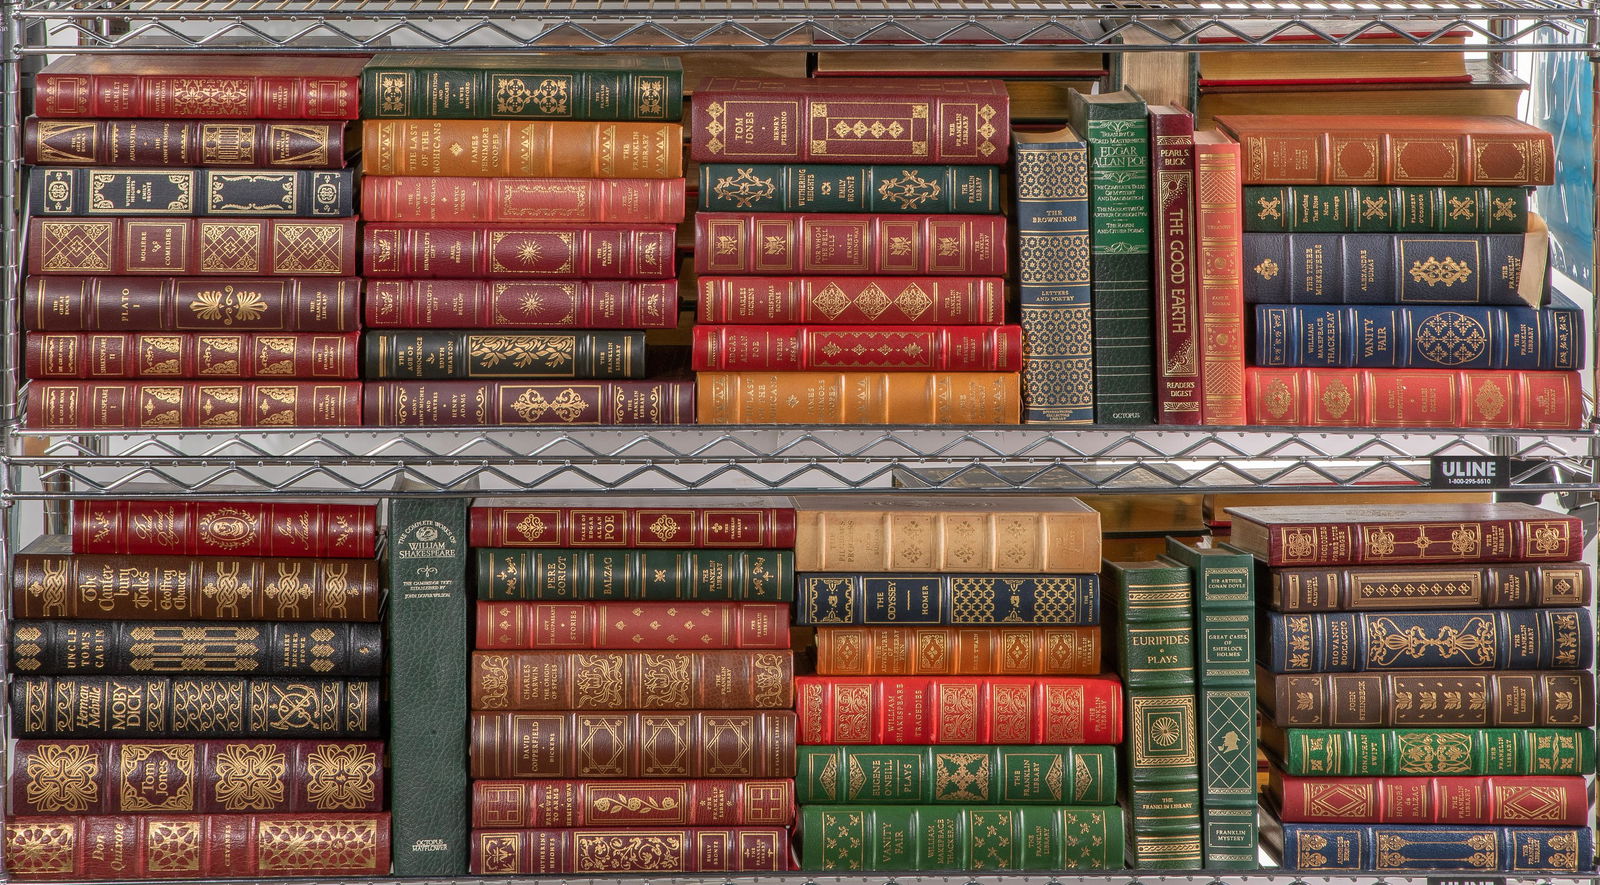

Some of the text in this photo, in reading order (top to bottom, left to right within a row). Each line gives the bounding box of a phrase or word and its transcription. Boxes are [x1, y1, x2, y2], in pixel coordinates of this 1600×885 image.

[735, 117, 743, 140] TOM
[746, 111, 754, 145] JONES
[409, 124, 418, 170] THE LAST
[421, 130, 429, 166] OF THE
[433, 122, 442, 174] MOHICANS
[481, 127, 489, 172] FENIMORE
[1091, 157, 1126, 168] ALLAN
[1100, 146, 1138, 158] EDGAR
[1160, 149, 1184, 157] PEARL
[1164, 158, 1186, 166] BUCK
[1169, 208, 1186, 334] THE GOOD EARTH
[1315, 244, 1323, 296] MUSKETEERS
[121, 288, 130, 321] PLATO
[408, 346, 413, 356] OF
[1327, 311, 1335, 364] THACKERAY
[1364, 318, 1374, 357] VANITY
[1378, 327, 1386, 351] FAIR
[1166, 381, 1195, 389] READER'S
[1442, 461, 1496, 476] ULINE
[278, 516, 296, 544] Jane
[295, 510, 309, 550] Austen
[604, 515, 615, 540] POE
[399, 550, 456, 559] SHAKESPEARE
[408, 542, 446, 550] WILLIAM
[80, 575, 98, 602] The
[115, 567, 139, 596] bury
[132, 571, 152, 609] Tales
[161, 570, 177, 610] Geoffrey
[174, 570, 187, 610] Chaucer
[557, 556, 567, 595] GORIOT
[604, 557, 612, 595] BALZAC
[888, 580, 897, 620] ODYSSEY
[921, 585, 929, 615] HOMER
[67, 628, 77, 669] UNCLE
[81, 631, 90, 667] TOM'S
[95, 629, 104, 668] CABIN
[1132, 635, 1190, 646] EURIPIDES
[1147, 655, 1178, 664] PLAYS
[76, 685, 89, 729] Herman
[89, 687, 101, 728] Melville
[112, 682, 126, 730] MOBY
[126, 685, 142, 727] DICK
[551, 691, 557, 699] OF
[914, 689, 923, 737] TRAGEDIES
[896, 684, 904, 743] SHAKESPEARE
[1360, 734, 1369, 774] JONATHAN
[141, 762, 155, 794] Tom
[156, 760, 169, 796] Jones
[872, 760, 881, 796] EUGENE
[884, 759, 893, 796] O'NEILL
[904, 763, 912, 792] PLAYS
[553, 813, 558, 822] TO
[1411, 786, 1419, 817] BALZAC
[92, 835, 104, 861] Don
[110, 823, 127, 871] Quixote
[882, 822, 892, 862] VANITY
[894, 830, 904, 854] FAIR
